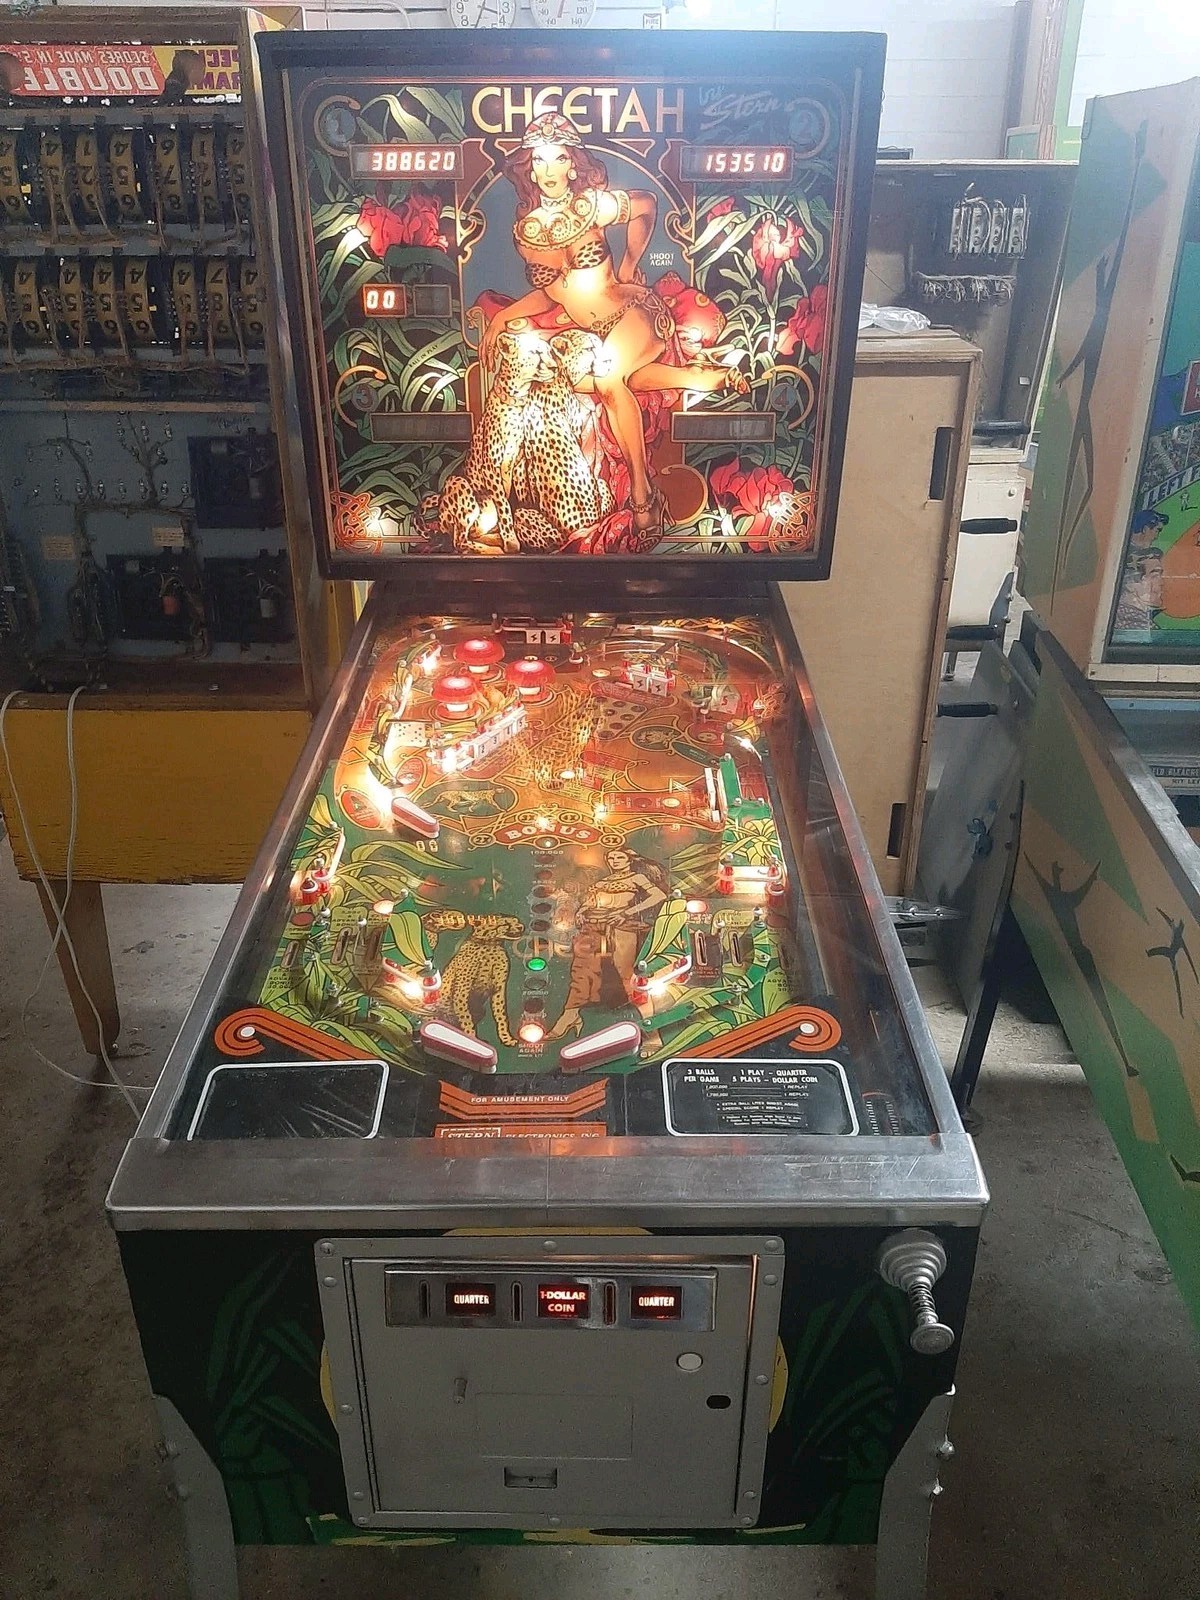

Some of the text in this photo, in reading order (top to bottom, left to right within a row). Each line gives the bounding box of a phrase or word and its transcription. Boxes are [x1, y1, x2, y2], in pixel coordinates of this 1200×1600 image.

[472, 86, 684, 134] CHEETAH
[371, 151, 456, 172] 388620
[705, 152, 786, 174] 153510
[504, 821, 591, 840] BONUS
[453, 1294, 490, 1305] QUARTER
[547, 1303, 575, 1312] COIN
[638, 1296, 675, 1307] QUARTER
